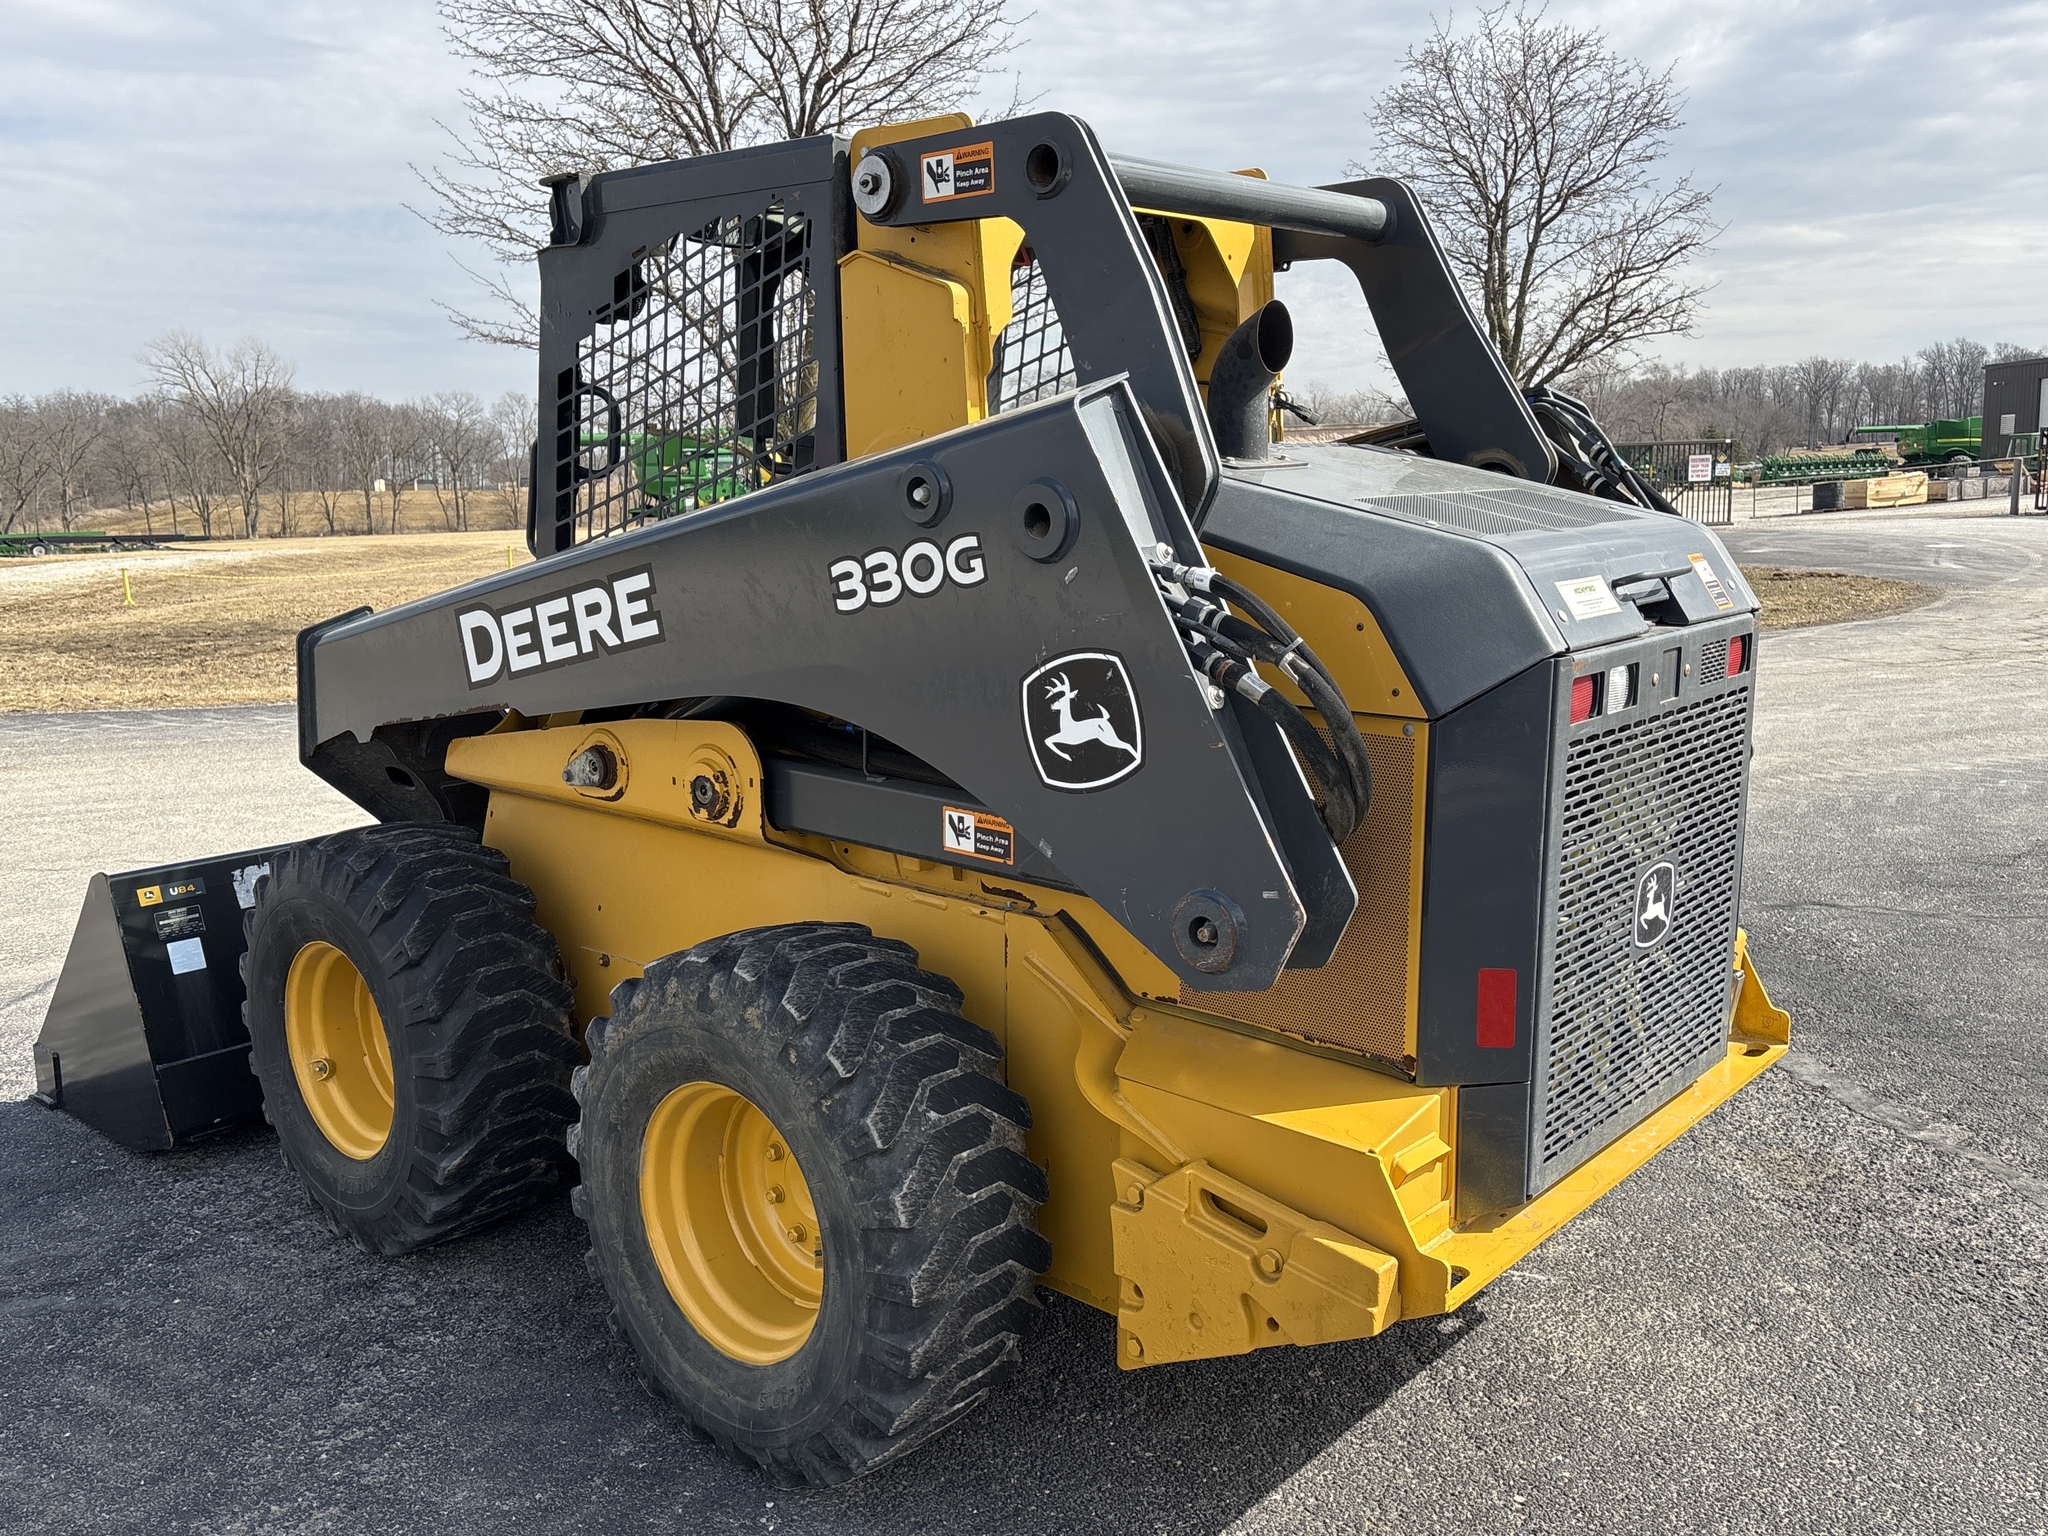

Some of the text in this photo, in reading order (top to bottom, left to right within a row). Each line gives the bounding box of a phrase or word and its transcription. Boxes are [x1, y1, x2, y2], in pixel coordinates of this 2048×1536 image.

[962, 147, 990, 158] WARNING
[956, 166, 989, 178] Pinch Area
[970, 178, 985, 186] Away
[829, 535, 986, 612] 330G
[458, 571, 660, 683] DEERE
[983, 818, 1010, 829] WARNING
[976, 832, 1009, 846] Pinch Area
[976, 842, 1004, 854] Keep Away
[169, 883, 196, 896] U84
